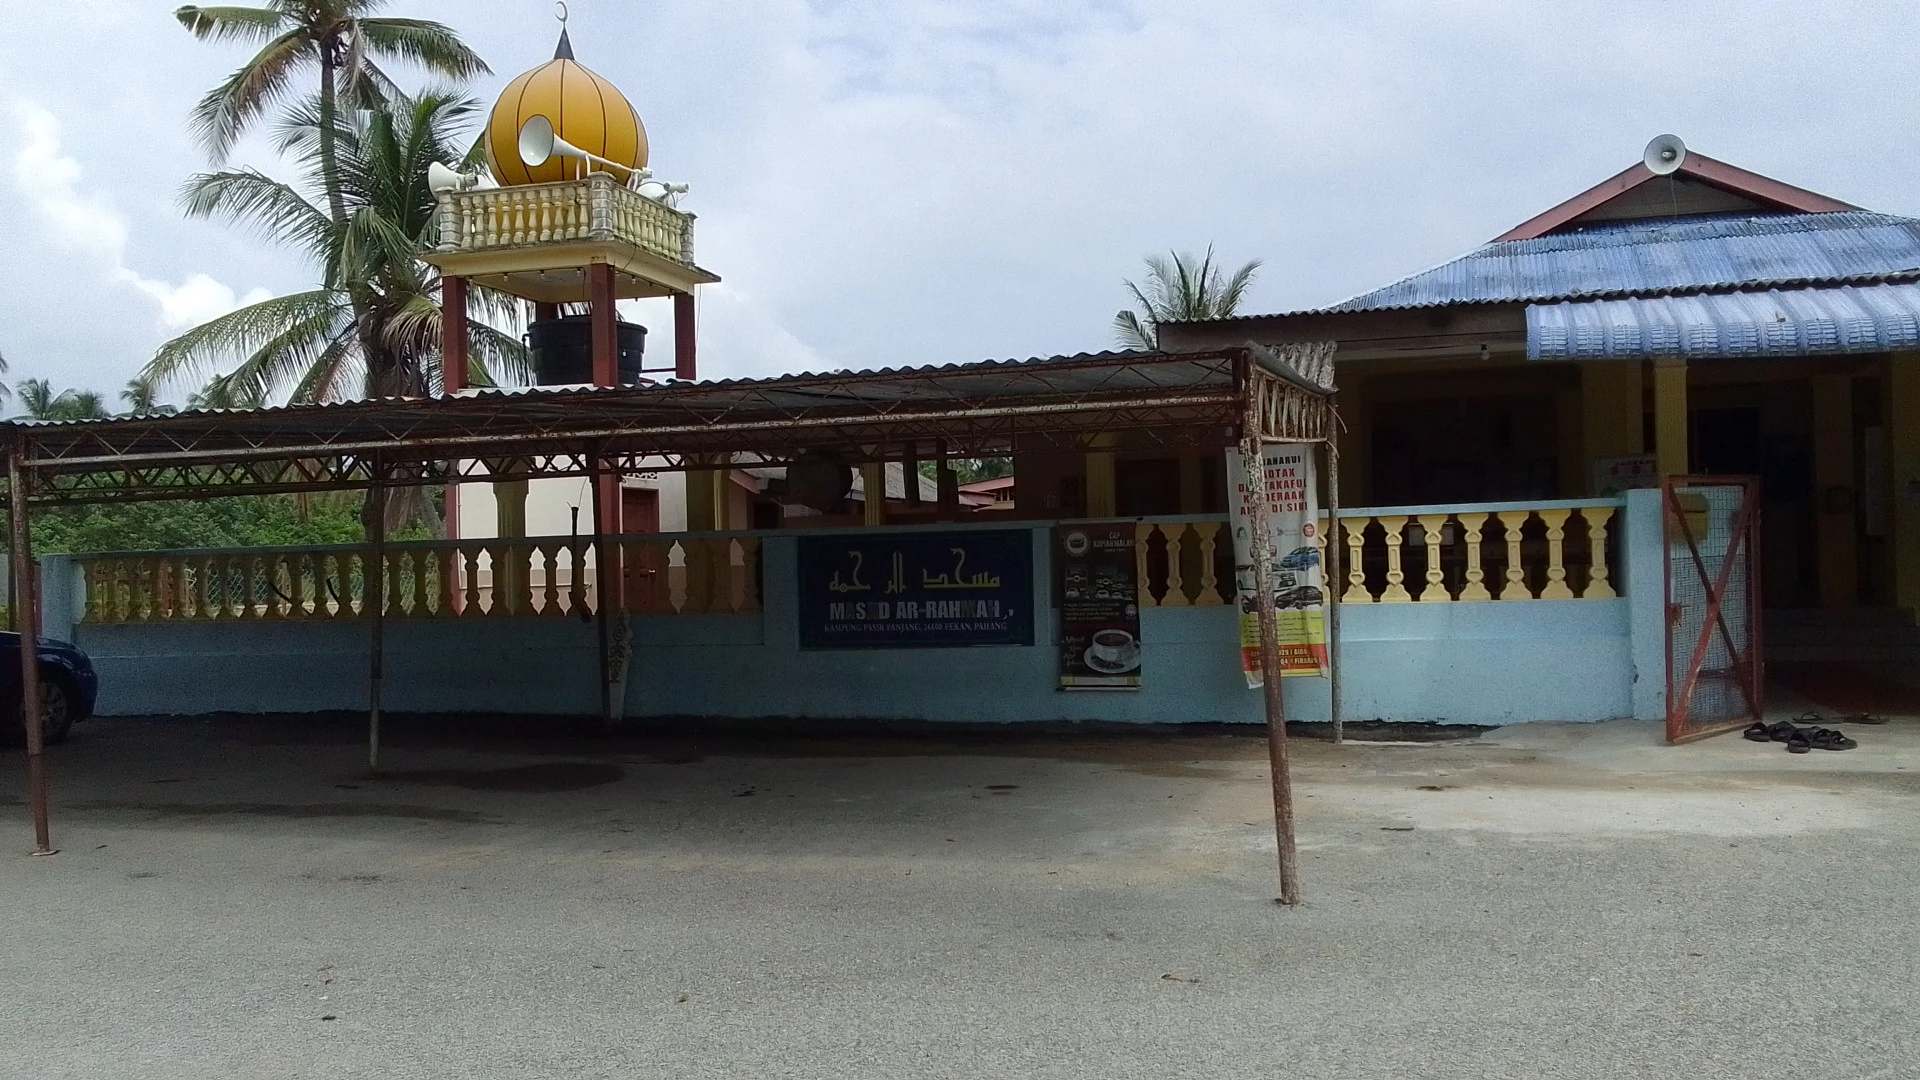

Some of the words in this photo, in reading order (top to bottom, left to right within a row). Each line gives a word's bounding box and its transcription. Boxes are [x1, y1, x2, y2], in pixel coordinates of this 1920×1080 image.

[1243, 455, 1301, 468] AHARUI
[1264, 467, 1295, 479] ADTAX
[1243, 490, 1305, 504] KDERAAN
[1272, 503, 1283, 513] DI
[830, 601, 890, 620] MASD
[824, 623, 862, 633] KAMPUNG
[863, 623, 884, 632] PASIR
[974, 621, 1007, 632] PAHANG
